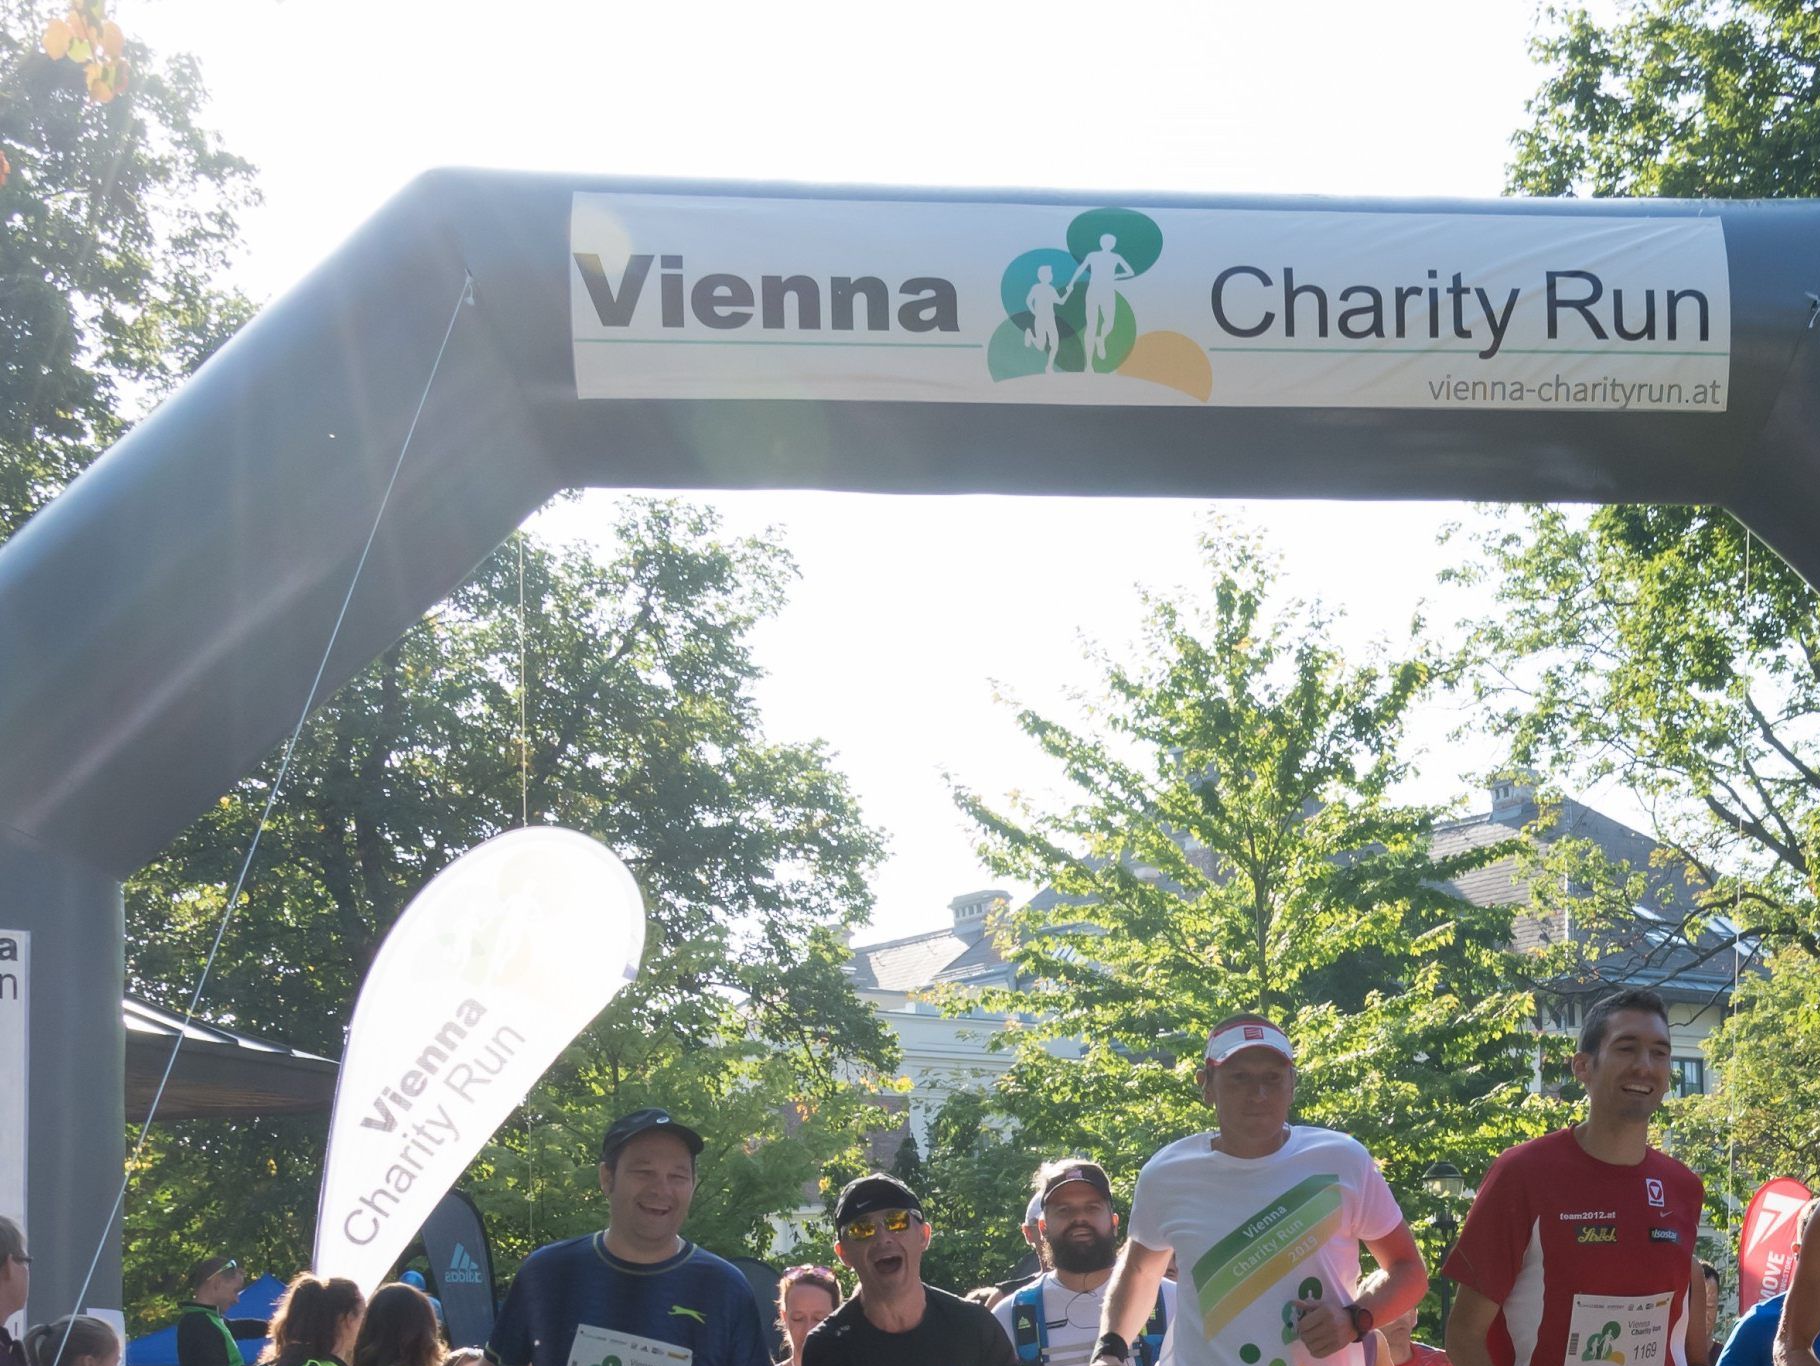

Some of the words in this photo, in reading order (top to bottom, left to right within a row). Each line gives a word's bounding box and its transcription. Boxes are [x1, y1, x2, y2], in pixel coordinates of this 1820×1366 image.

[573, 252, 961, 333] Vienna
[1210, 265, 1521, 360] Charity
[1546, 270, 1710, 342] Run
[1428, 374, 1722, 409] vienna-charityrun.at
[360, 998, 488, 1133] Vienna
[344, 1103, 461, 1246] Charity
[443, 1025, 526, 1103] Run
[1242, 1204, 1288, 1239] Vienna
[1559, 1211, 1617, 1221] team2012.at
[1232, 1238, 1279, 1278] Charity
[1275, 1219, 1304, 1242] Run
[1288, 1235, 1318, 1264] 2019
[1633, 1341, 1657, 1361] 1169
